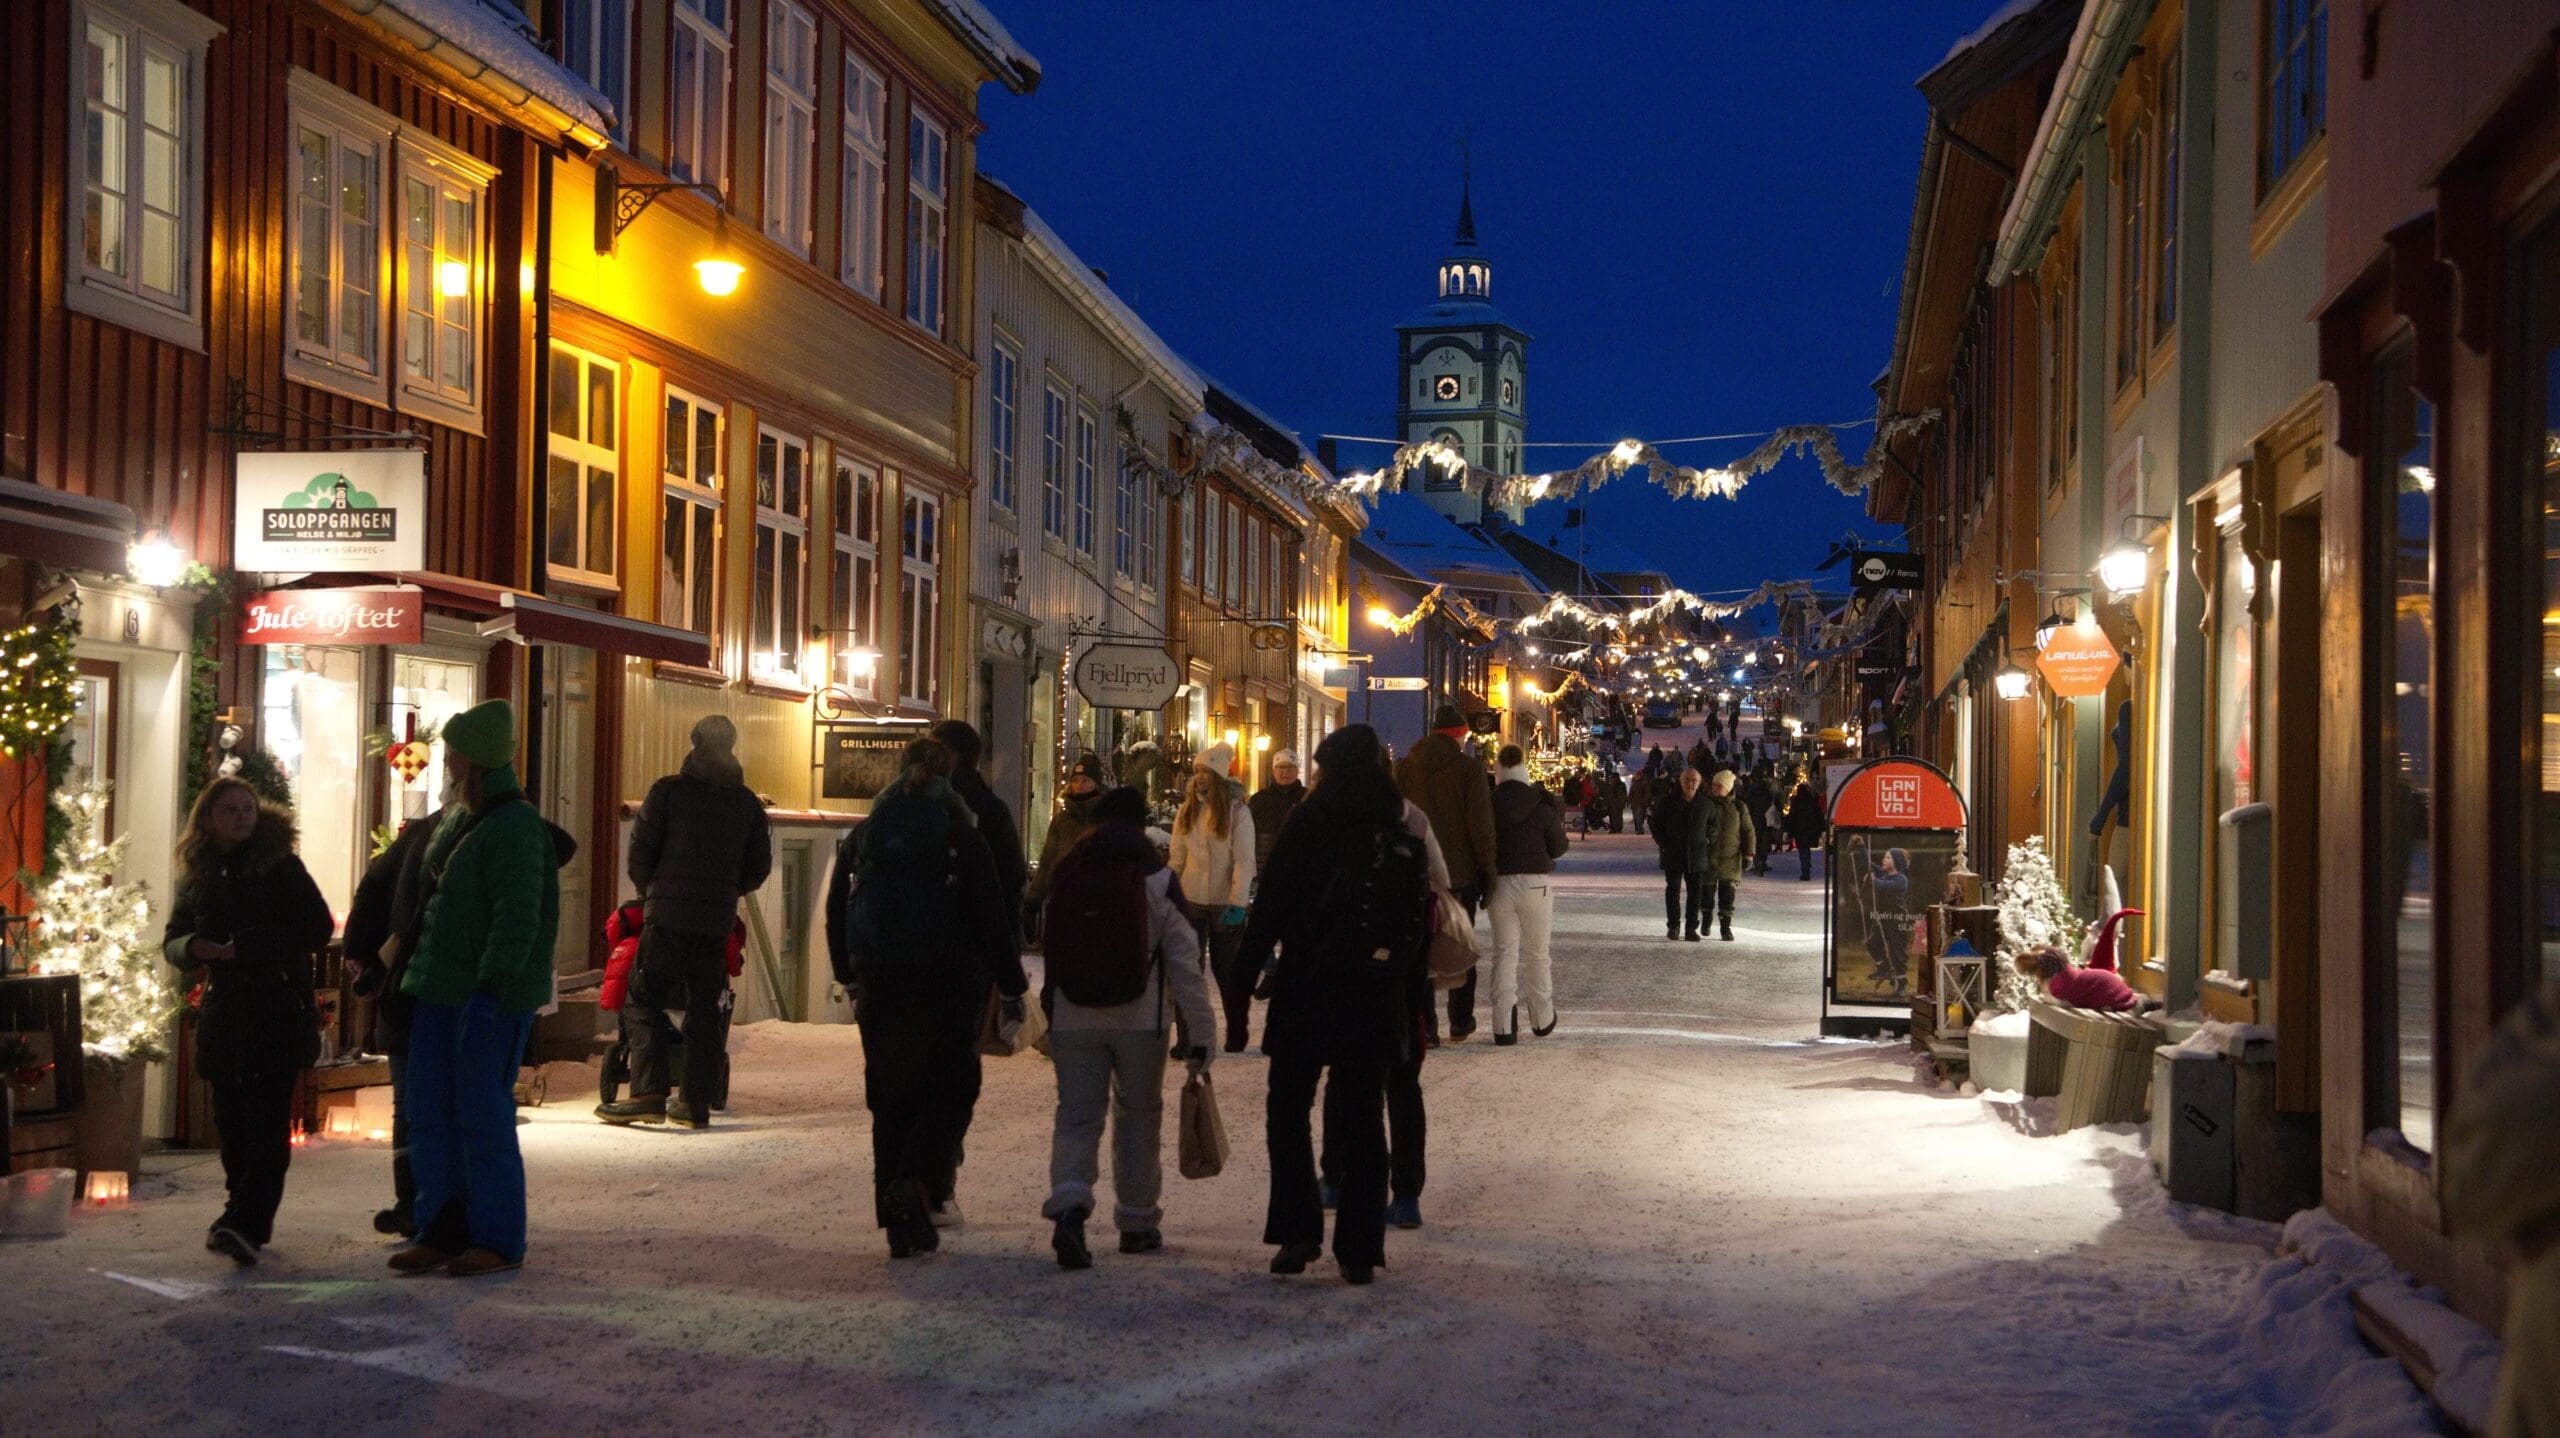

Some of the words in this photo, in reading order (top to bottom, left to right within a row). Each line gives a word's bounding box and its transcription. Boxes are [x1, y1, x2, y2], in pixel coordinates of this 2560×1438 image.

[268, 513, 391, 529] SOLOPPGANGEN
[129, 611, 137, 634] 6
[1089, 662, 1166, 688] Fjellpryd
[841, 739, 907, 749] GRILLHUSET
[1881, 780, 1915, 791] LAN
[1881, 791, 1915, 802] ULL
